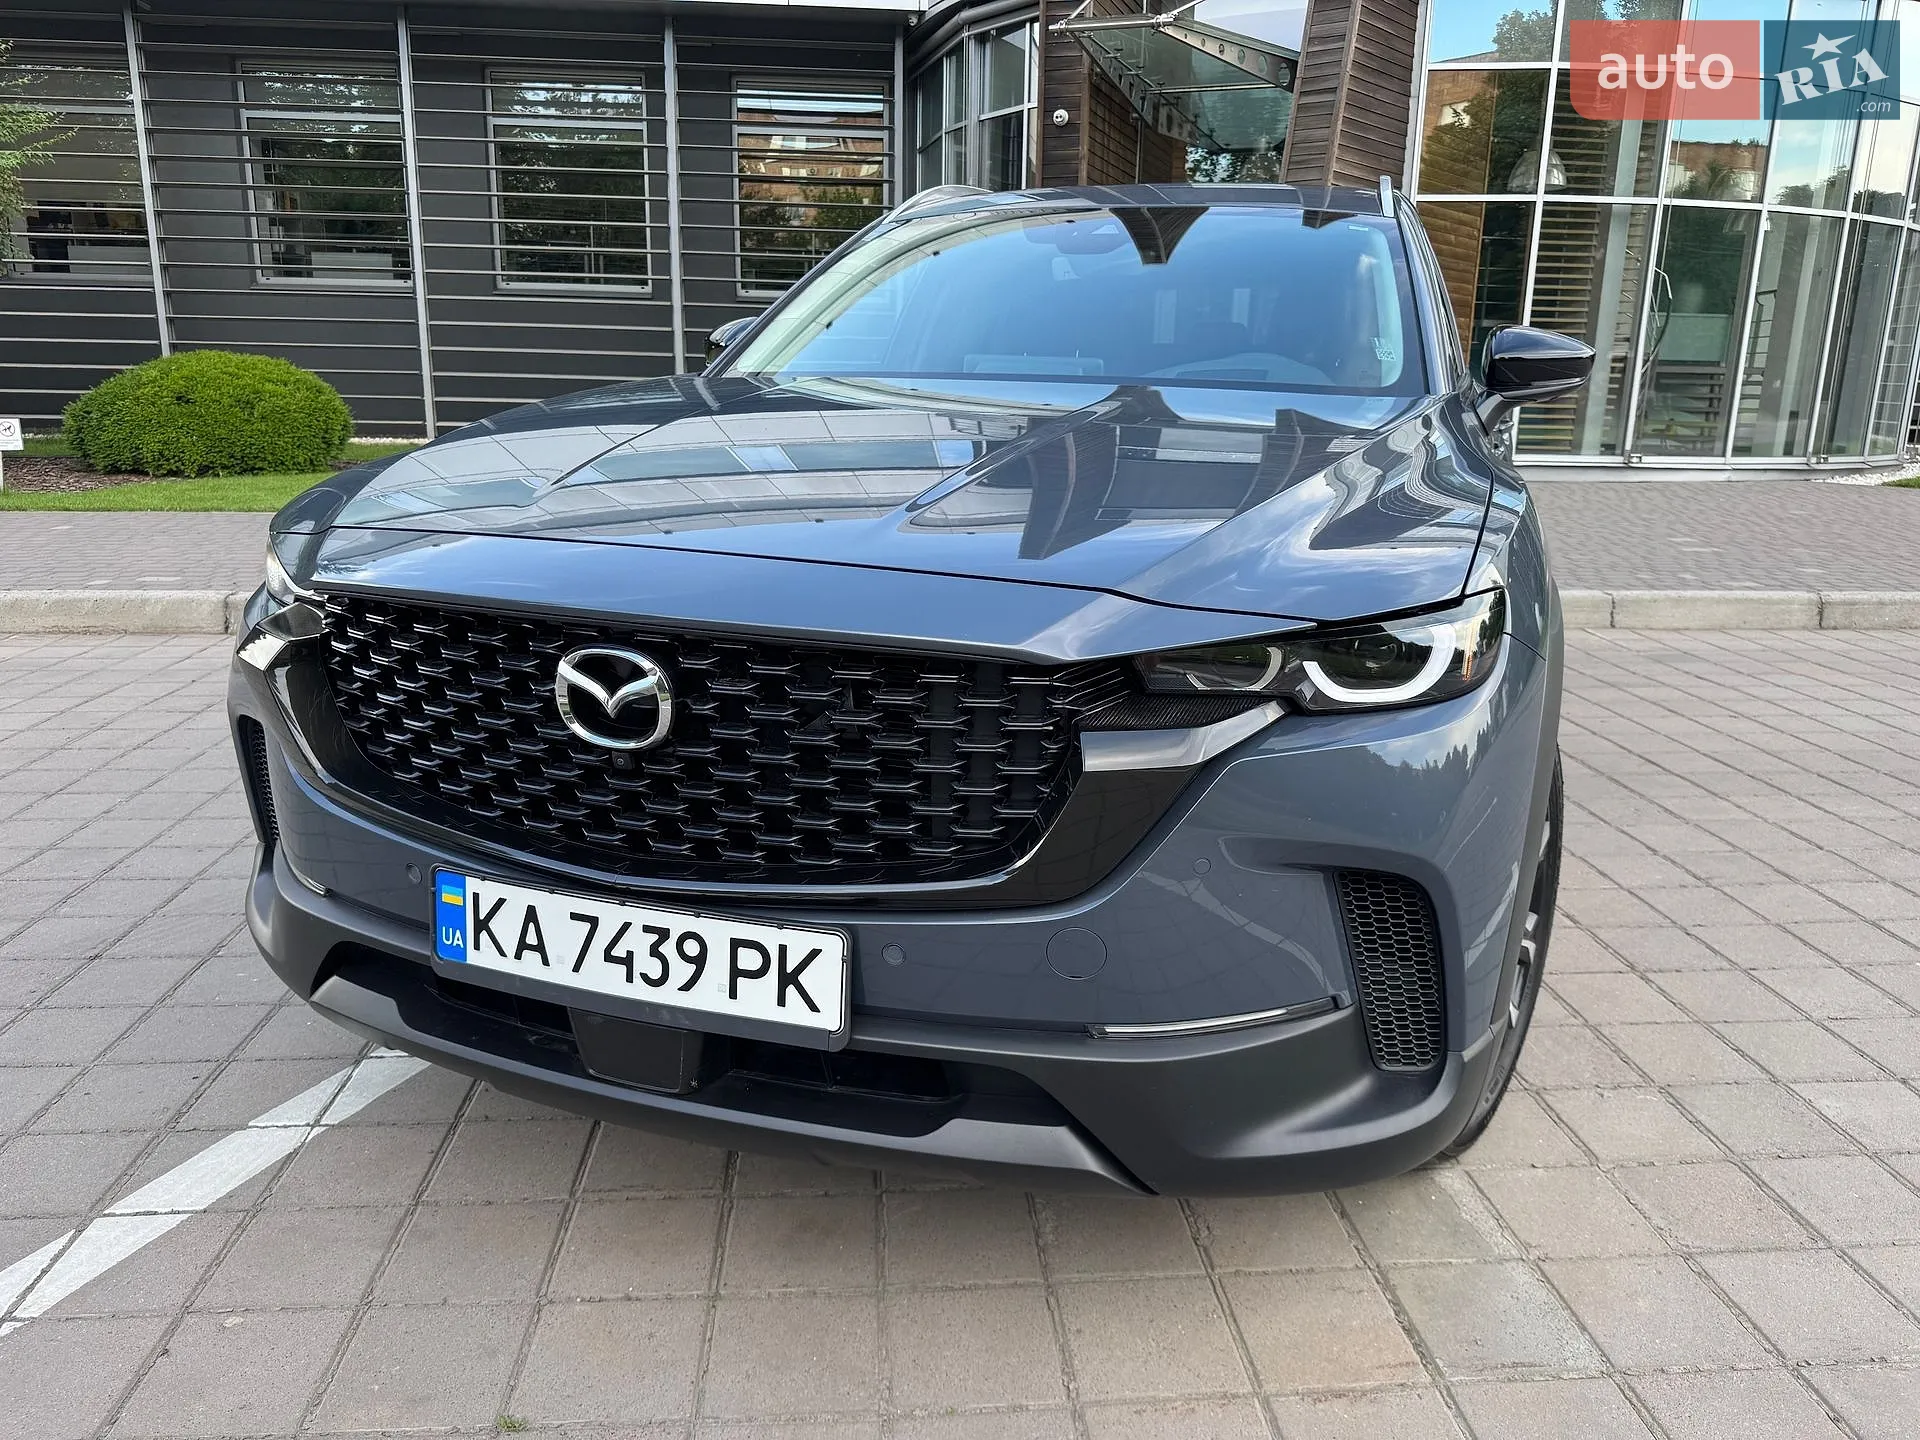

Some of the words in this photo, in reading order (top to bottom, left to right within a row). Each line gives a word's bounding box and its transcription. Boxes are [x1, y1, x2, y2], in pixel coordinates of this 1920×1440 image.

[442, 926, 464, 949] UA
[472, 892, 551, 967] KA
[569, 911, 709, 992] 7439
[728, 937, 823, 1013] PK
